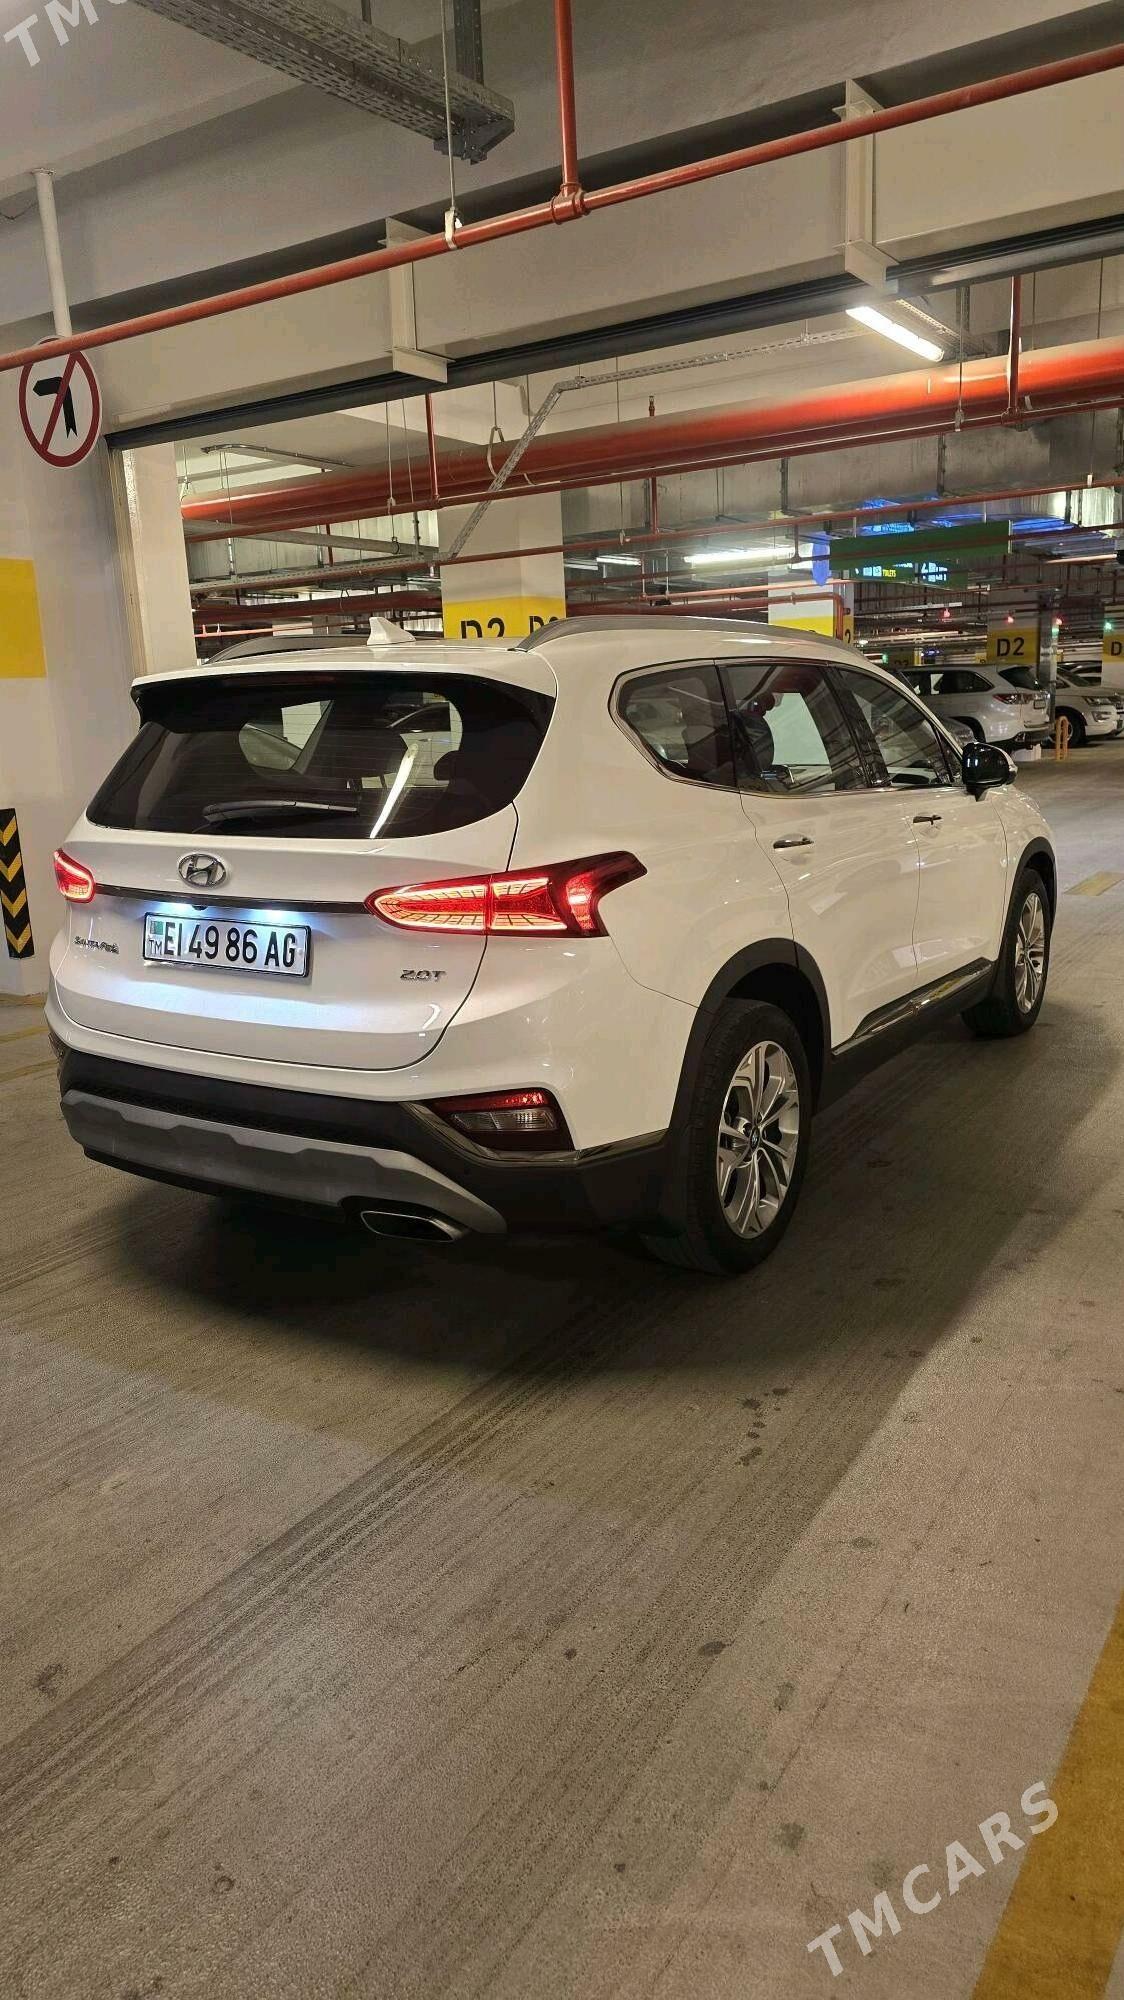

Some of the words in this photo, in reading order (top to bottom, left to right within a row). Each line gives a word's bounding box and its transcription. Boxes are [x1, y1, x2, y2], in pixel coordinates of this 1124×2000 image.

[997, 637, 1025, 657] D2
[149, 938, 163, 955] TM
[188, 924, 220, 960] 49
[225, 927, 259, 963] 86
[264, 931, 297, 967] AG
